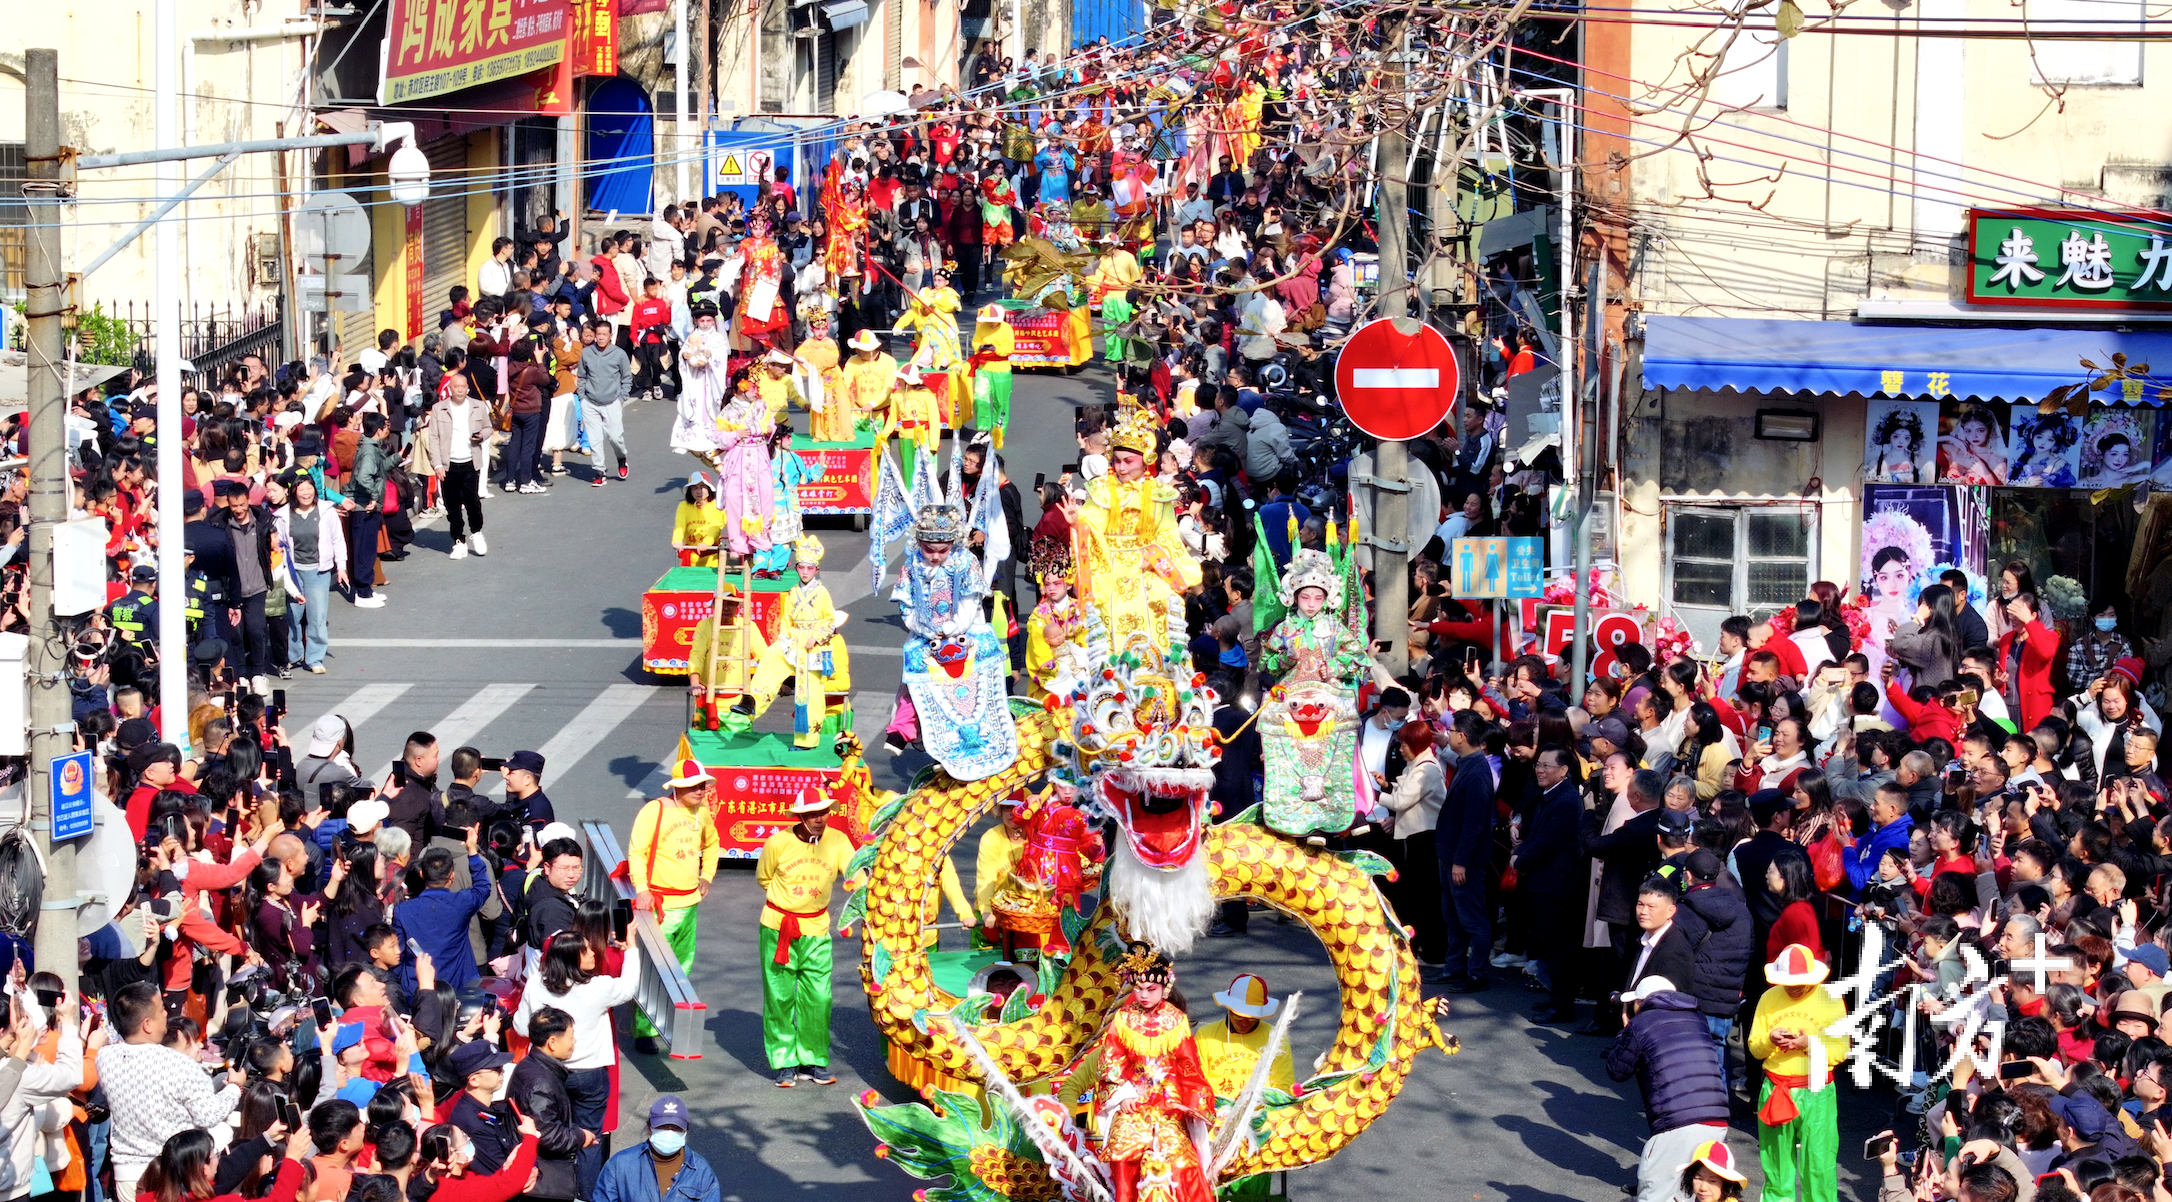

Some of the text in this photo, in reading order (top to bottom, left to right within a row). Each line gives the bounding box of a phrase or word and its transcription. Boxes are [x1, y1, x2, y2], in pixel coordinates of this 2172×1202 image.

[1881, 370, 1950, 395] 簪花
[1517, 545, 1535, 556] 公共
[1511, 559, 1540, 569] 卫生间
[1511, 572, 1540, 582] Toilet
[112, 606, 134, 622] 警察
